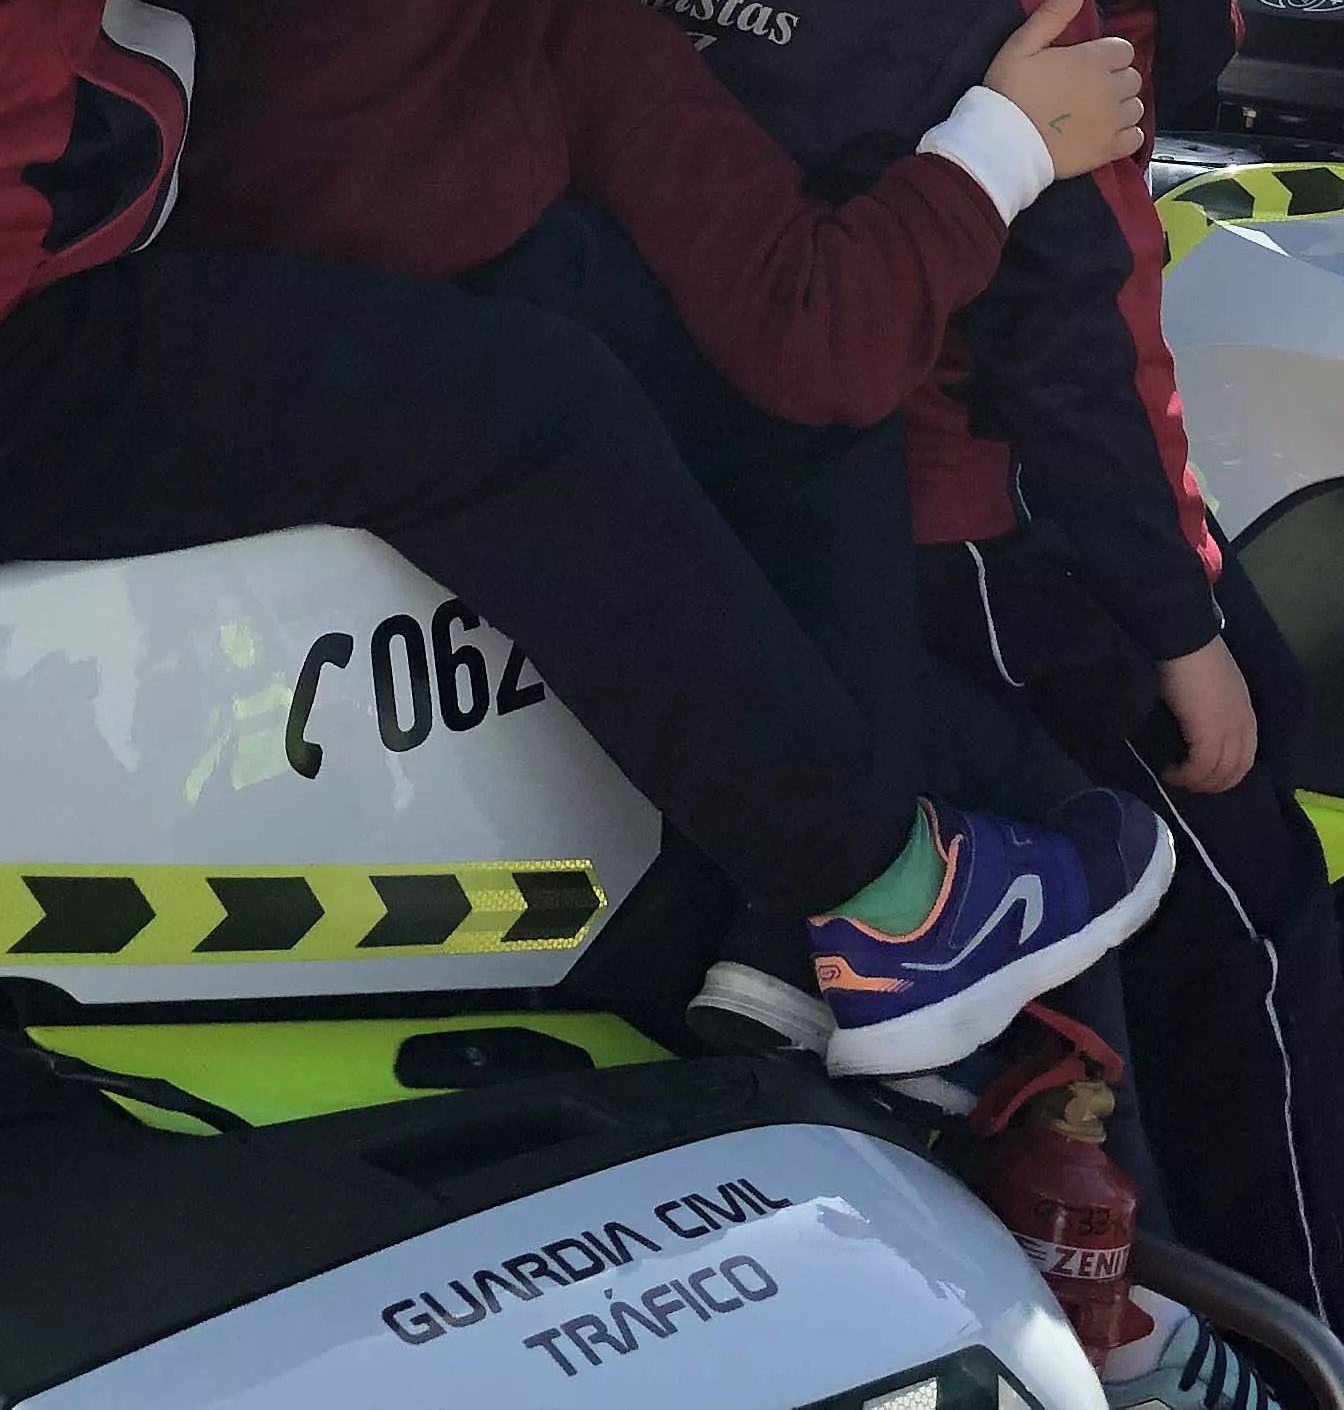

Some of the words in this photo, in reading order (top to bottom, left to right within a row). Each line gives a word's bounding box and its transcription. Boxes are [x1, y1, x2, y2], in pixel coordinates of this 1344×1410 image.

[381, 1221, 662, 1345] GUARDIA
[654, 1178, 793, 1239] CIVIL
[523, 1255, 779, 1377] TRÁFICO
